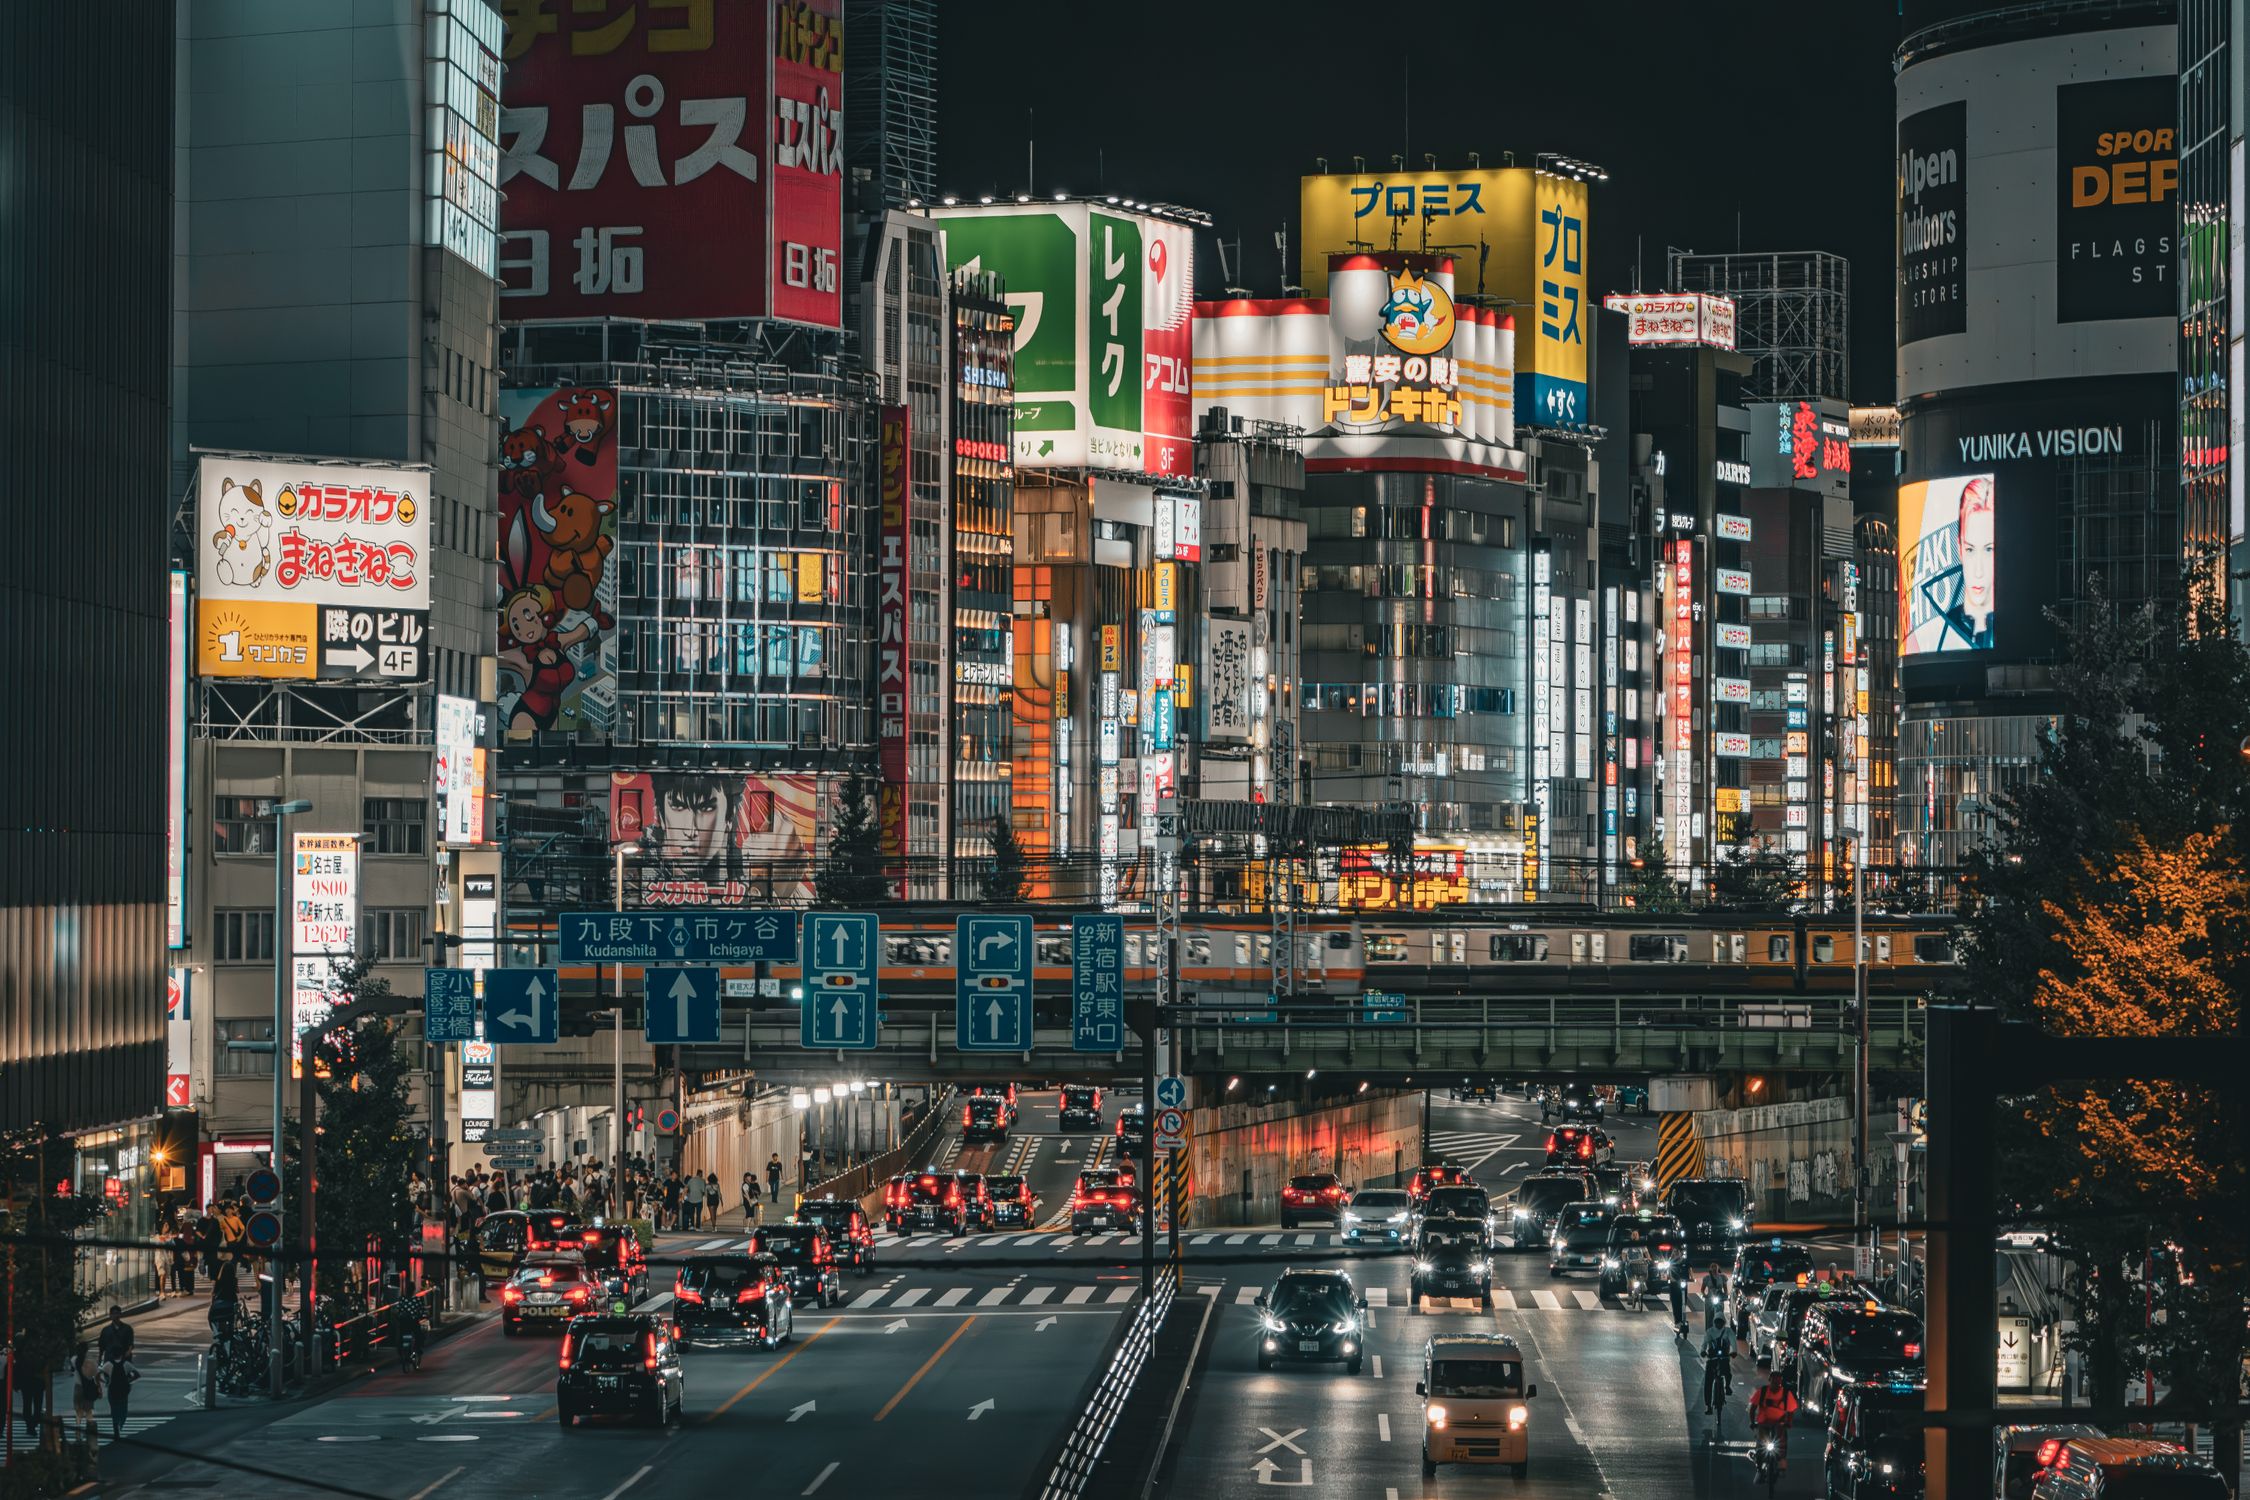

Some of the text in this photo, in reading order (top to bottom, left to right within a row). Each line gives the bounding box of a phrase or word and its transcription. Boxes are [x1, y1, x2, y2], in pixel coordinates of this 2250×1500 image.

[2096, 128, 2178, 157] SPOR
[1900, 148, 1957, 205] Alpen
[1350, 181, 1486, 218] プロミス
[1903, 205, 1957, 256] Outdoors
[786, 241, 837, 293] 日拓
[1643, 302, 1687, 314] カラオケ
[1914, 283, 1958, 308] STORE
[1102, 225, 1126, 397] レイク
[1635, 318, 1694, 336] まねきねこ
[964, 365, 1007, 388] SHISHA
[1146, 353, 1190, 395] アコム
[956, 438, 1008, 462] GGPOKER
[1959, 426, 2123, 463] YUNIKA VISION
[1160, 447, 1175, 470] 3F
[883, 420, 903, 528] パチンコ
[1716, 461, 1750, 485] DARTS
[296, 482, 398, 523] カラオケ
[1728, 520, 1746, 536] カラオケ
[276, 528, 417, 589] まねきねこ
[1728, 575, 1746, 590] カラオケ
[881, 535, 903, 683] エスパス
[325, 609, 423, 644] 隣のビル
[248, 645, 308, 664] ワンカラ
[383, 650, 413, 672] 4F
[314, 855, 342, 875] 名古屋
[311, 879, 348, 897] 9800
[313, 902, 344, 922] 新大阪
[304, 924, 347, 943] 12620
[578, 917, 664, 942] 九段下
[584, 943, 764, 957] Kudanshita Ichigaya
[1079, 925, 1095, 986] Shinjuku
[1094, 921, 1117, 1043] 新宿駅東口
[448, 974, 472, 1038] 小滝橋
[519, 1305, 570, 1317] POLICE
